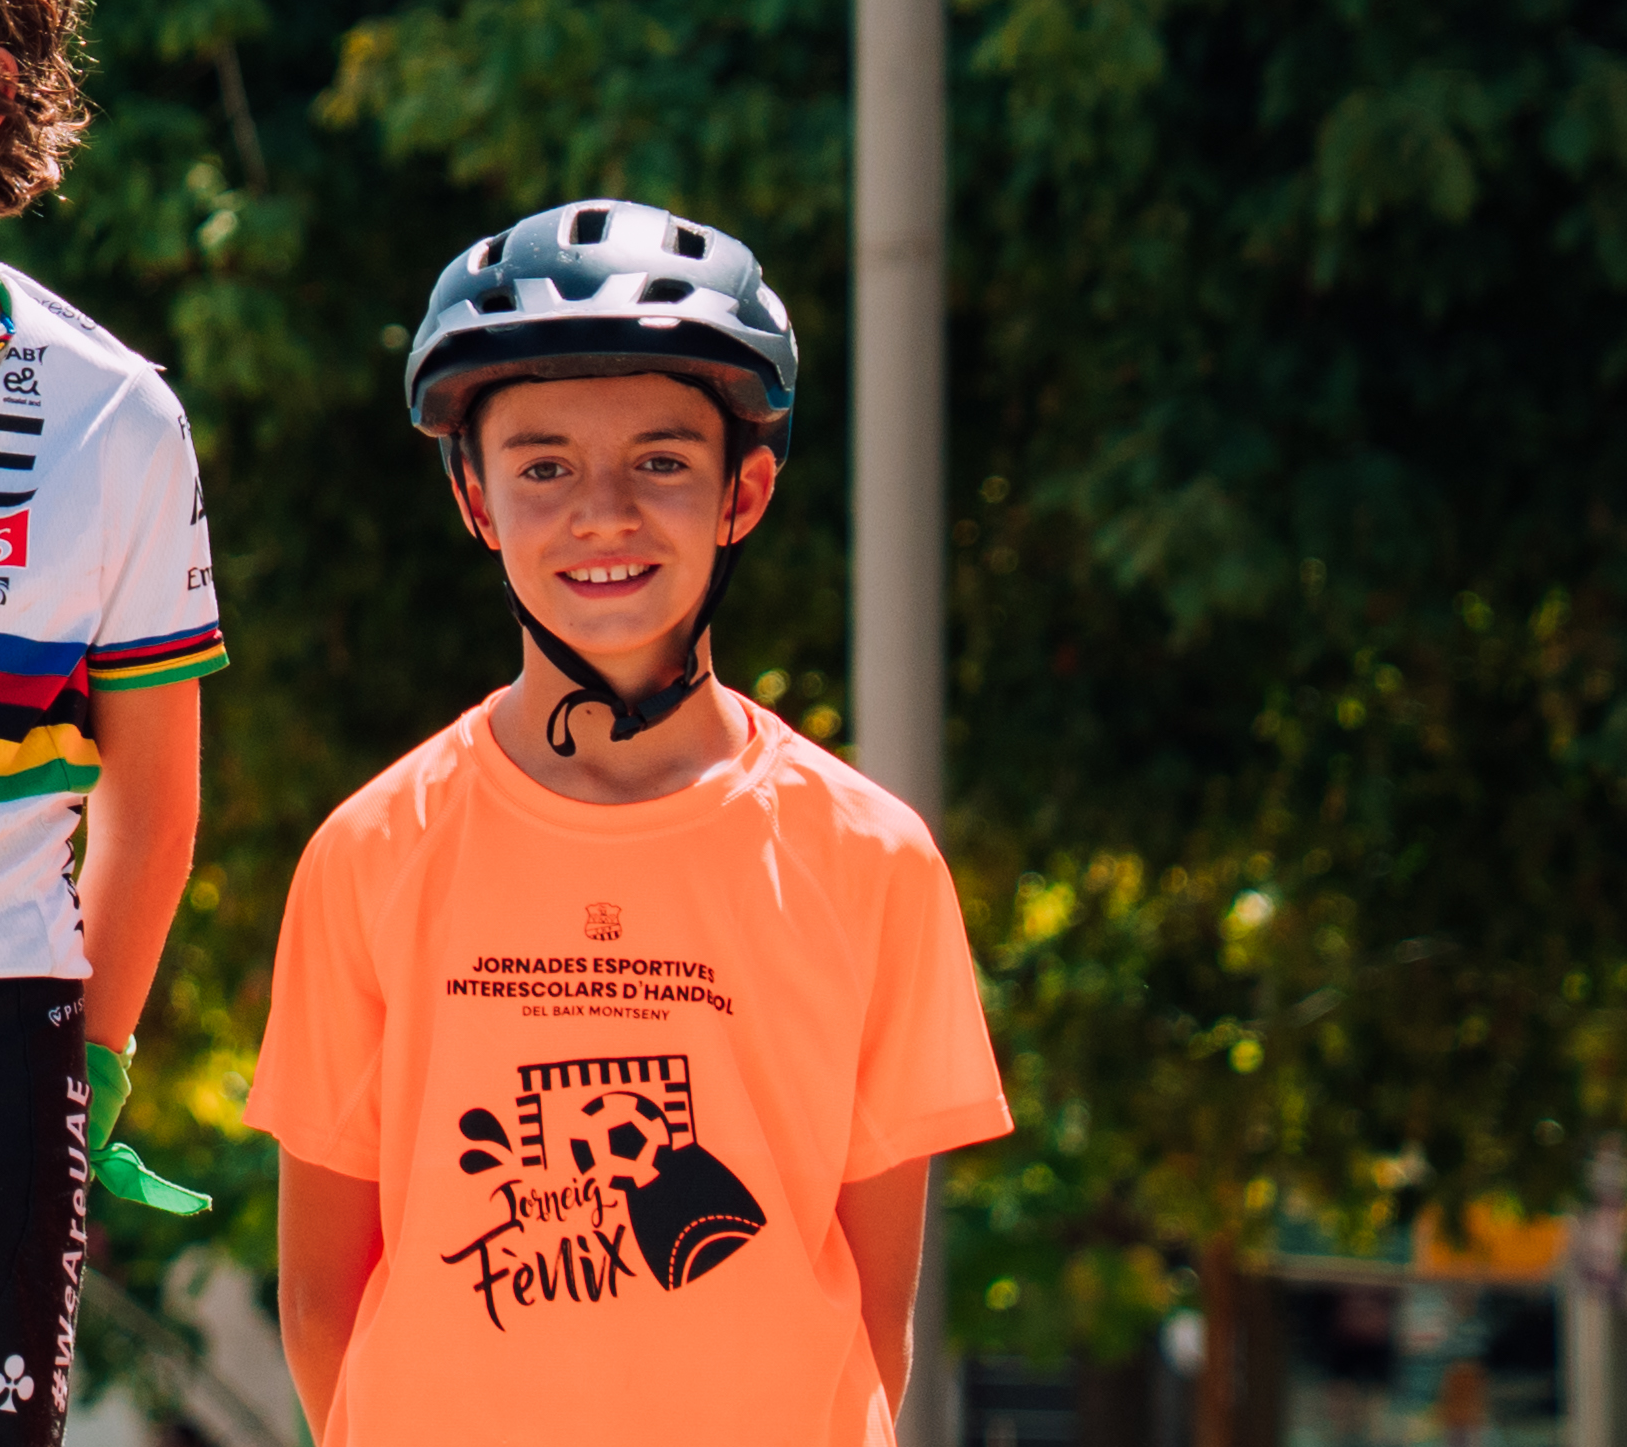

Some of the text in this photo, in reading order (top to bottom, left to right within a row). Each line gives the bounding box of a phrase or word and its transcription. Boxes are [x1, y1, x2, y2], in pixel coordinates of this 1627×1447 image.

[472, 956, 716, 984] JORNADES ESPORTIVES
[446, 978, 618, 1000] INTERESCOLARS
[522, 1004, 671, 1022] DEL BAIX MONTSENY
